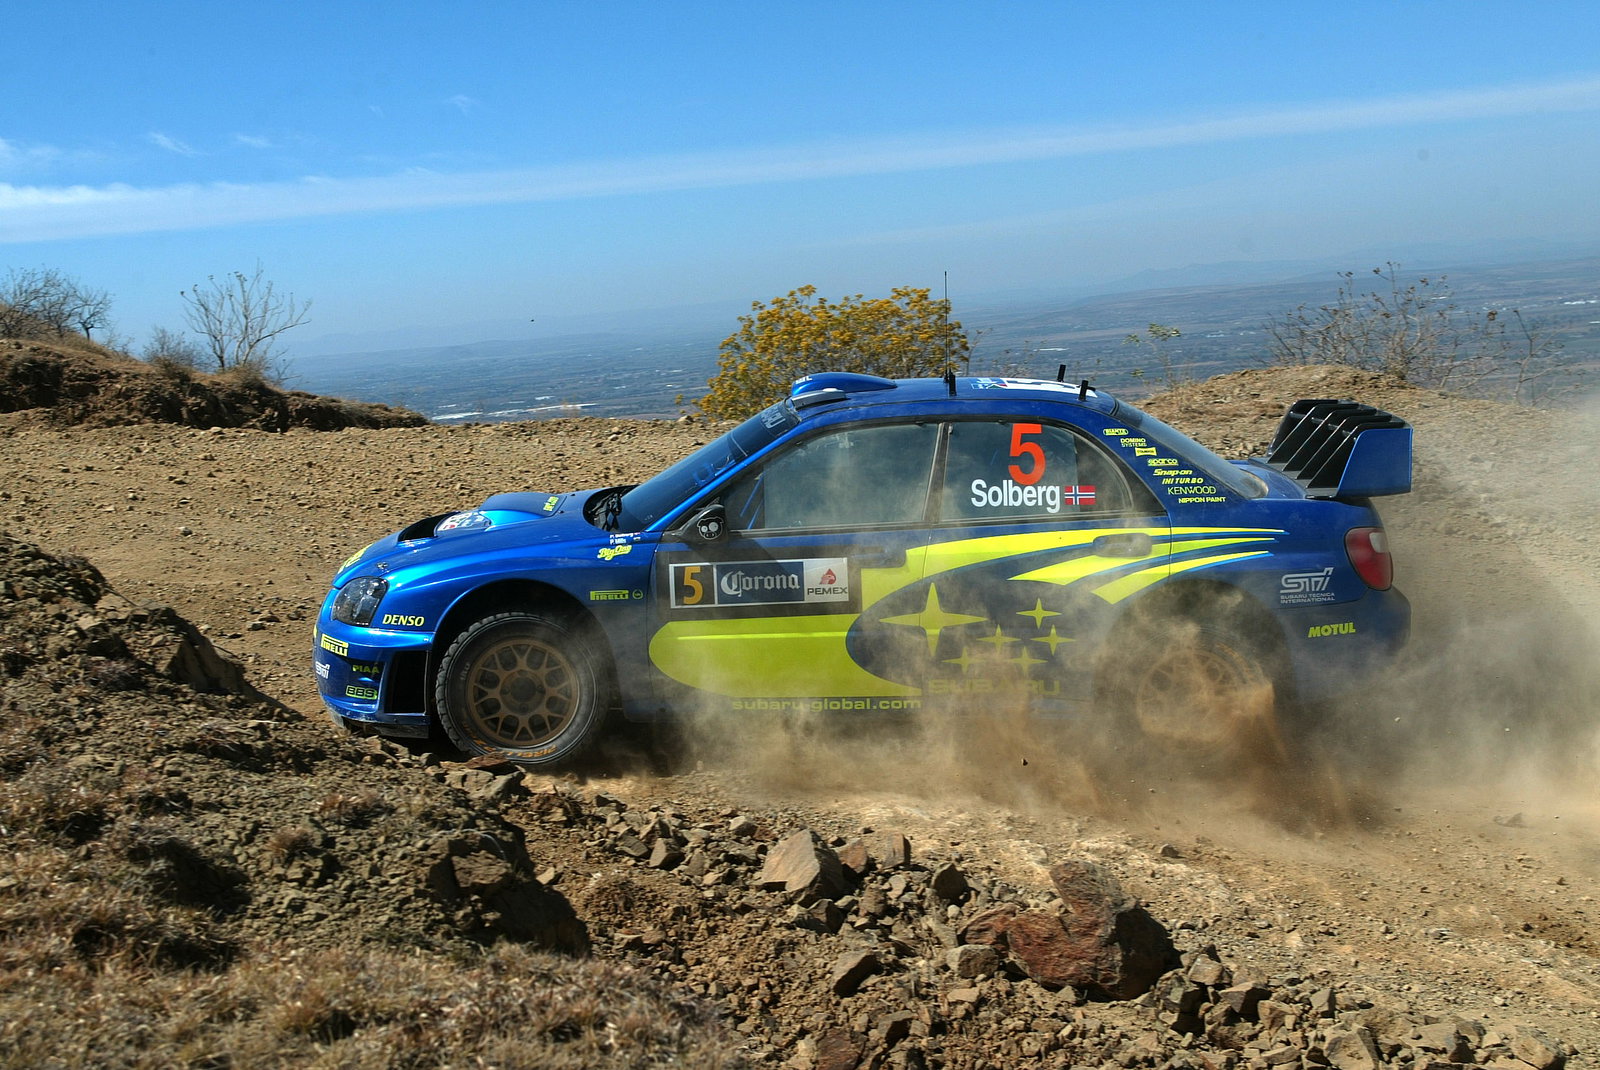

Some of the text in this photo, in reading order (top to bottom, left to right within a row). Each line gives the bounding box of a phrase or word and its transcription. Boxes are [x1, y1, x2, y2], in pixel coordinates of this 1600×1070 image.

[1008, 423, 1046, 486] 5
[971, 479, 1061, 513] Solberg
[1167, 486, 1217, 495] KENWOOD
[683, 566, 801, 605] 5 Corona
[807, 587, 848, 596] PEMEX
[590, 590, 629, 600] PIRELLI
[382, 614, 425, 627] DENSO
[1308, 622, 1356, 638] MOTUL
[320, 633, 349, 657] PIRELLI
[352, 664, 380, 674] PIAA
[346, 685, 377, 699] BBS
